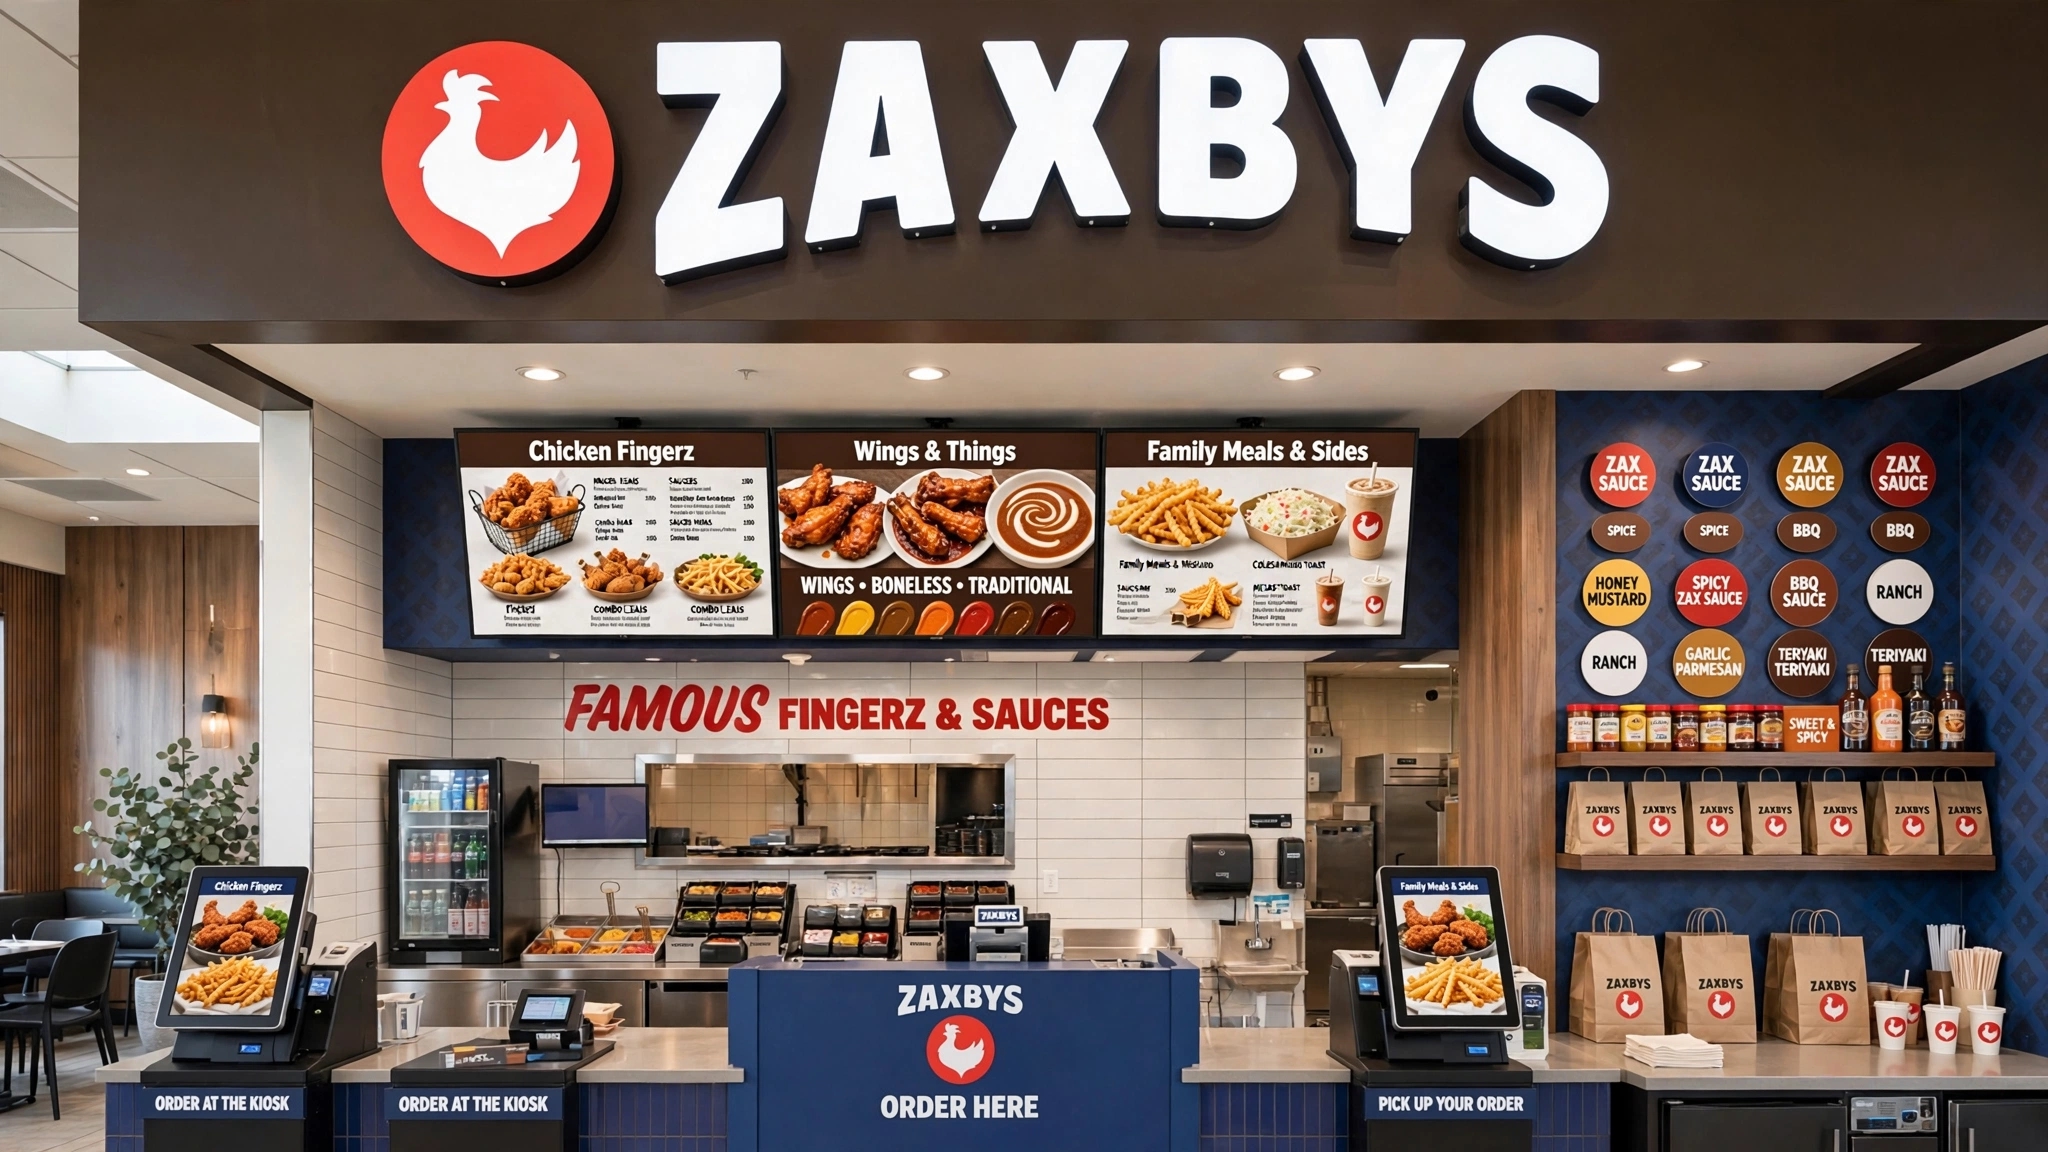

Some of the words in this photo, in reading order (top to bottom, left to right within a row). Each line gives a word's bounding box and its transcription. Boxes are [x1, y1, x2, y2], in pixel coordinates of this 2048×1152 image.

[655, 34, 1610, 282] ZAXBYS
[529, 440, 611, 461] Chicken
[616, 440, 695, 466] Fingerz
[854, 440, 919, 465] Wings
[925, 440, 941, 461] &
[946, 440, 1016, 465] Things
[1148, 440, 1217, 465] Family
[1223, 440, 1284, 461] Meals
[1290, 440, 1306, 461] &
[1312, 440, 1368, 461] Sides
[1606, 455, 1641, 473] ZAX
[1699, 455, 1734, 473] ZAX
[1793, 456, 1827, 473] ZAX
[1886, 456, 1921, 473] ZAX
[1599, 475, 1648, 491] SAUCE
[1692, 475, 1741, 491] SAUCE
[1785, 475, 1834, 491] SAUCE
[1879, 475, 1928, 491] SAUCE
[1608, 525, 1636, 536] SPICE
[1700, 525, 1729, 536] SPICE
[1793, 524, 1820, 538] BBQ
[1887, 524, 1914, 539] BBQ
[801, 576, 854, 594] WINGS
[872, 576, 952, 594] BONELESS
[968, 576, 1072, 594] TRADITIONAL
[1596, 576, 1638, 590] HONEY
[1693, 576, 1730, 590] SPICY
[1791, 576, 1819, 592] BBQ
[1588, 592, 1646, 606] MUSTARD
[1676, 592, 1701, 606] ZAX
[1704, 592, 1742, 605] SAUCE
[1783, 591, 1826, 607] SAUCE
[1877, 585, 1922, 599] RANCH
[1686, 647, 1730, 663] GARLIC
[1778, 647, 1826, 661] TERYAKI
[1871, 648, 1926, 662] TERIYAKI
[1593, 655, 1636, 669] RANCH
[1676, 662, 1741, 676] PARMESAN
[1775, 663, 1829, 676] TERIYAKI
[563, 682, 769, 732] FAMOUS
[779, 698, 925, 730] FINGERZ
[936, 698, 962, 730] &
[973, 698, 1109, 730] SAUCES
[1790, 718, 1823, 732] SWEET
[1826, 718, 1835, 733] &
[1797, 728, 1830, 743] SPICY
[1585, 806, 1620, 814] ZAXBYS
[1642, 806, 1677, 814] ZAXBYS
[1700, 806, 1734, 814] ZAXBYS
[1758, 806, 1792, 814] ZAXBYS
[1823, 806, 1858, 814] ZAXBYS
[1895, 806, 1930, 814] ZAXBYS
[1948, 806, 1982, 814] ZAXBYS
[215, 881, 248, 890] Chicken
[250, 881, 283, 893] Fingerz
[1401, 882, 1426, 892] Family
[1458, 882, 1478, 890] Sides
[1607, 979, 1650, 989] ZAXBYS
[1699, 979, 1743, 989] ZAXBYS
[1811, 981, 1857, 992] ZAXBYS
[898, 985, 1023, 1016] ZAXBYS
[155, 1096, 199, 1110] ORDER
[203, 1096, 219, 1110] AT
[221, 1096, 246, 1110] THE
[250, 1096, 289, 1110] KIOSK
[399, 1096, 448, 1112] ORDER
[451, 1096, 470, 1111] AT
[473, 1096, 500, 1111] THE
[504, 1096, 548, 1111] KIOSK
[881, 1095, 966, 1118] ORDER
[974, 1096, 1038, 1118] HERE
[1379, 1096, 1409, 1111] PICK
[1414, 1096, 1433, 1111] UP
[1436, 1096, 1473, 1111] YOUR
[1477, 1096, 1523, 1111] ORDER
